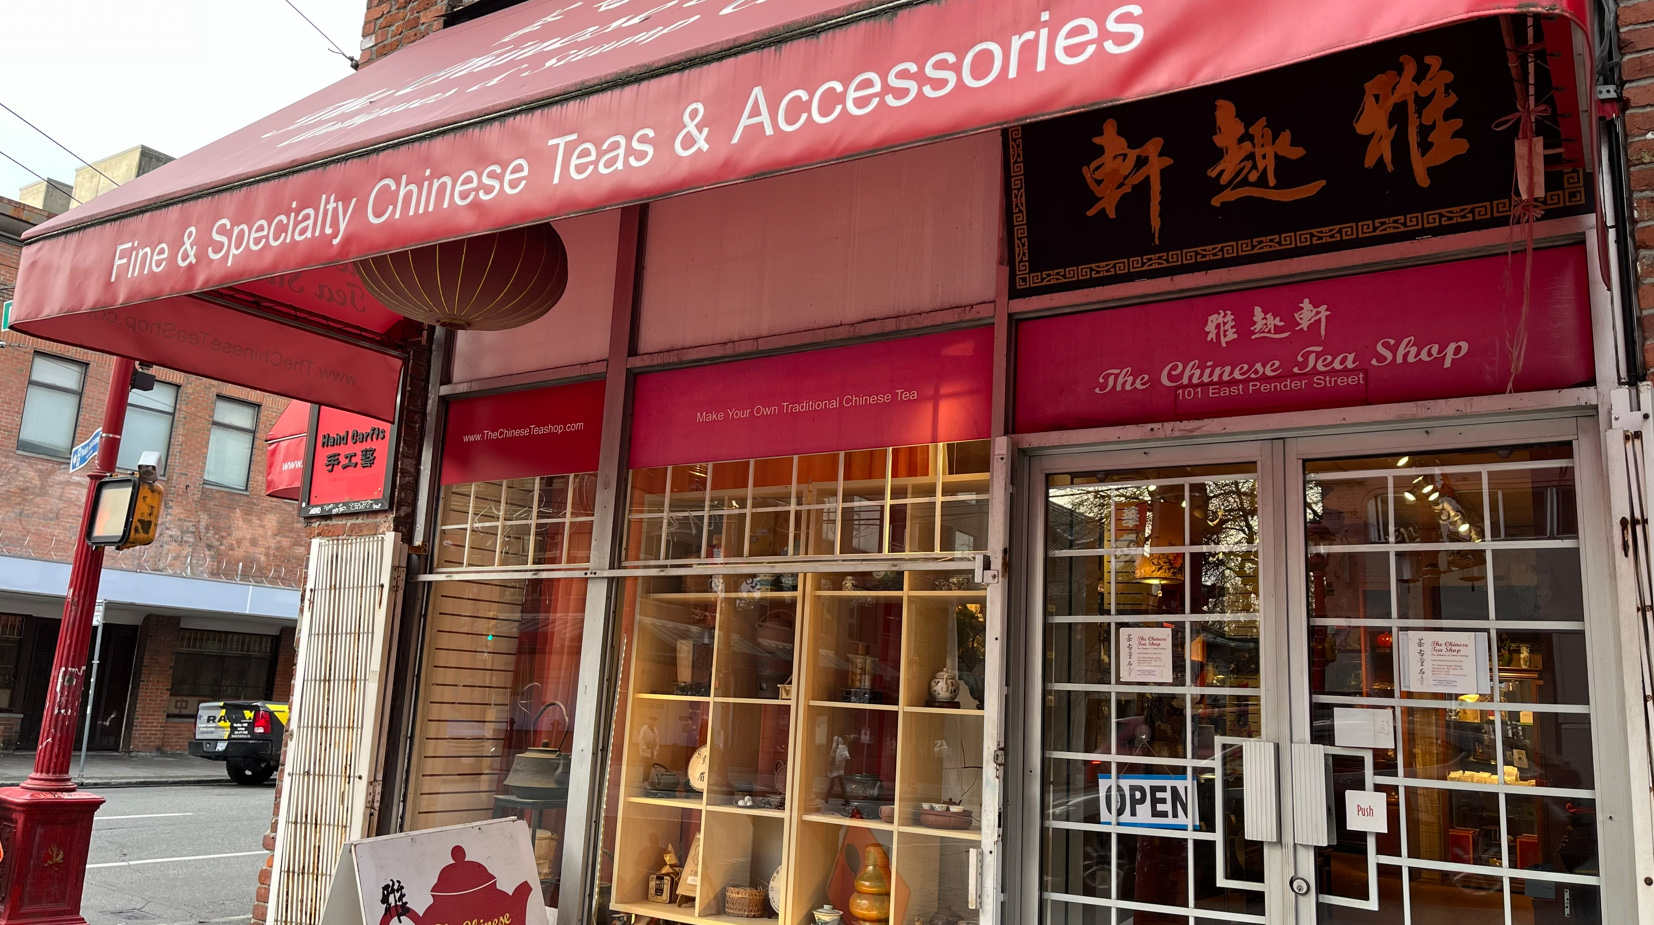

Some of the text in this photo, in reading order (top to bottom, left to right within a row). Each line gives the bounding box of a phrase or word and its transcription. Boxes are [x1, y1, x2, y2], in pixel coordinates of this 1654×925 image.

[519, 15, 701, 77] Stamp
[110, 3, 1146, 283] Fine & Specialty Chinese Teas & Accessories
[1094, 335, 1469, 394] The Chinese Tea Shop
[1176, 371, 1365, 401] 101 East Pender Street
[696, 389, 918, 423] Make Your Own Traditional Chinese Tea
[321, 426, 386, 448] Hand Carfts
[462, 421, 584, 443] www.TheChineseTeashop.com
[325, 447, 377, 473] 手工藝
[1444, 640, 1469, 648] Chinese
[1444, 646, 1462, 655] Shop
[206, 715, 230, 724] RA
[1105, 784, 1188, 819] OPEN
[1356, 804, 1374, 818] Push
